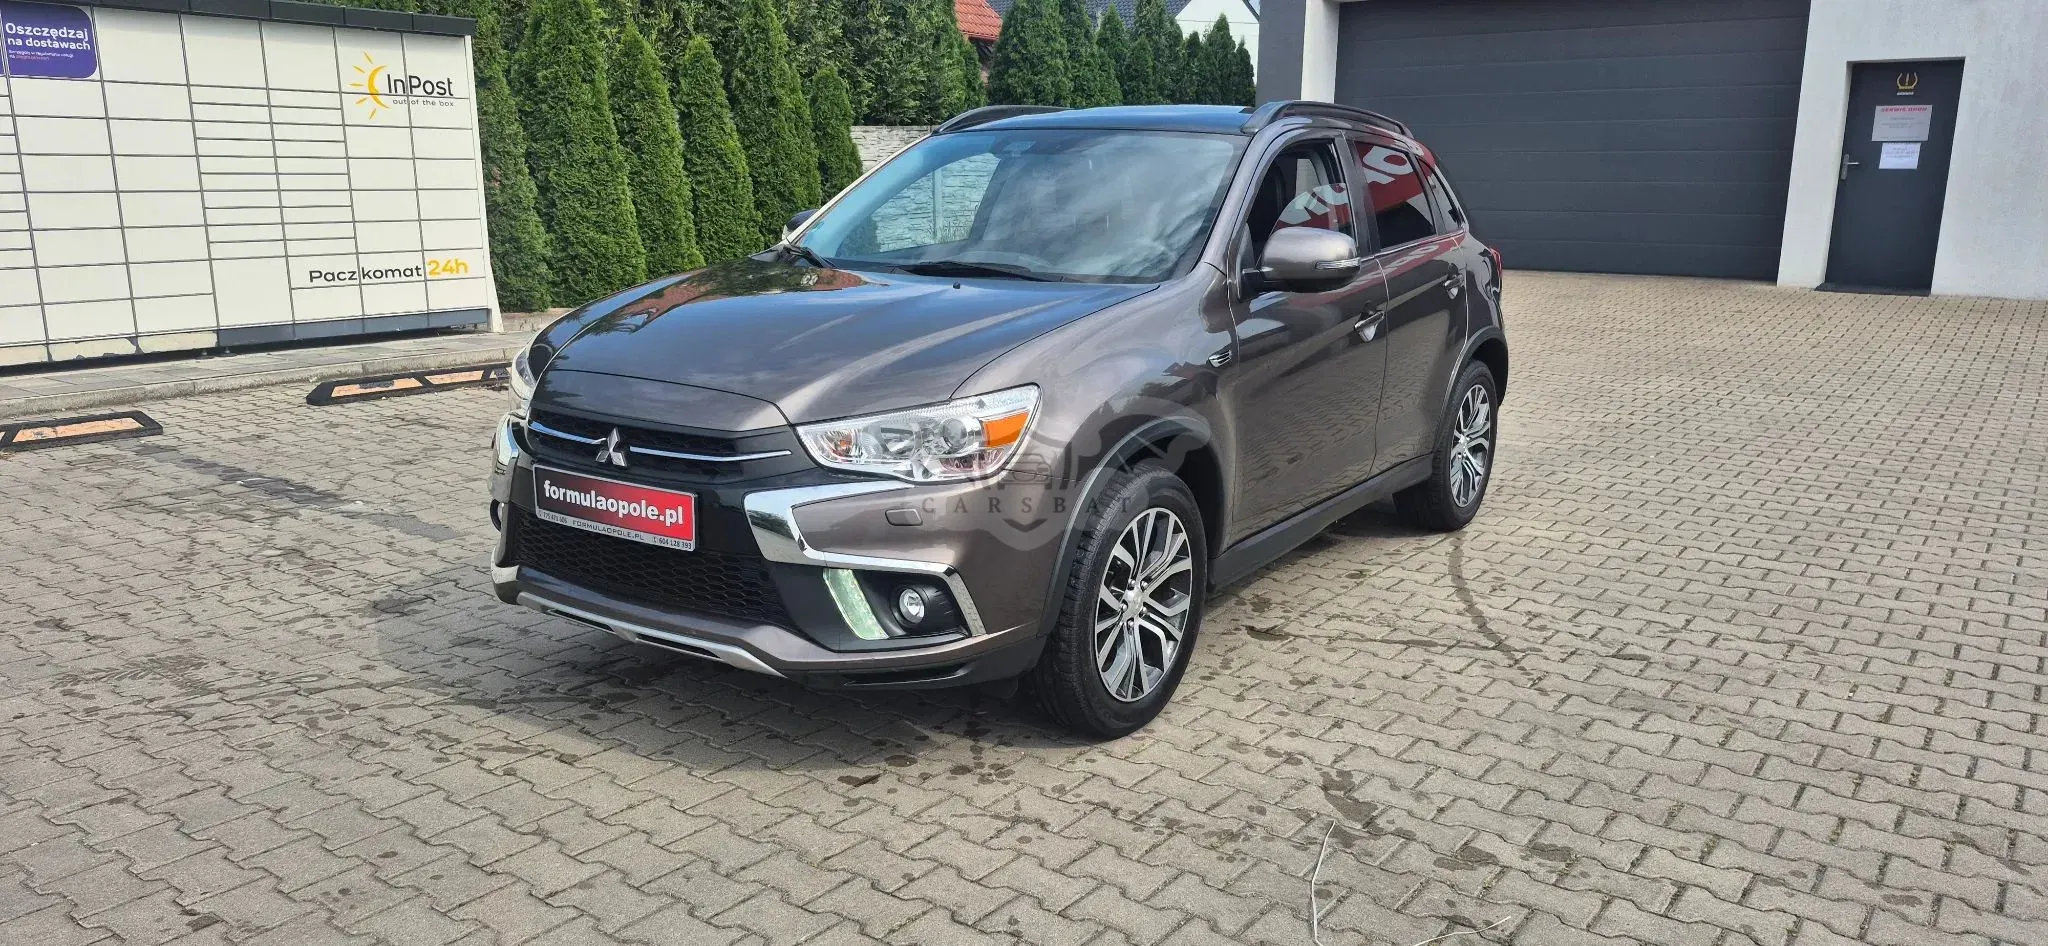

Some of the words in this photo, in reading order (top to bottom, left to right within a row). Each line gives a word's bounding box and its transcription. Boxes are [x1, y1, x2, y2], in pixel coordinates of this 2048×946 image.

[5, 23, 88, 41] Oszczędzaj
[8, 37, 23, 46] na
[26, 38, 90, 50] dostawach
[387, 74, 454, 96] InPost
[428, 259, 469, 276] 24h
[544, 479, 684, 527] formulaopole.pl
[572, 519, 645, 541] FORMULAOPOLE.PL
